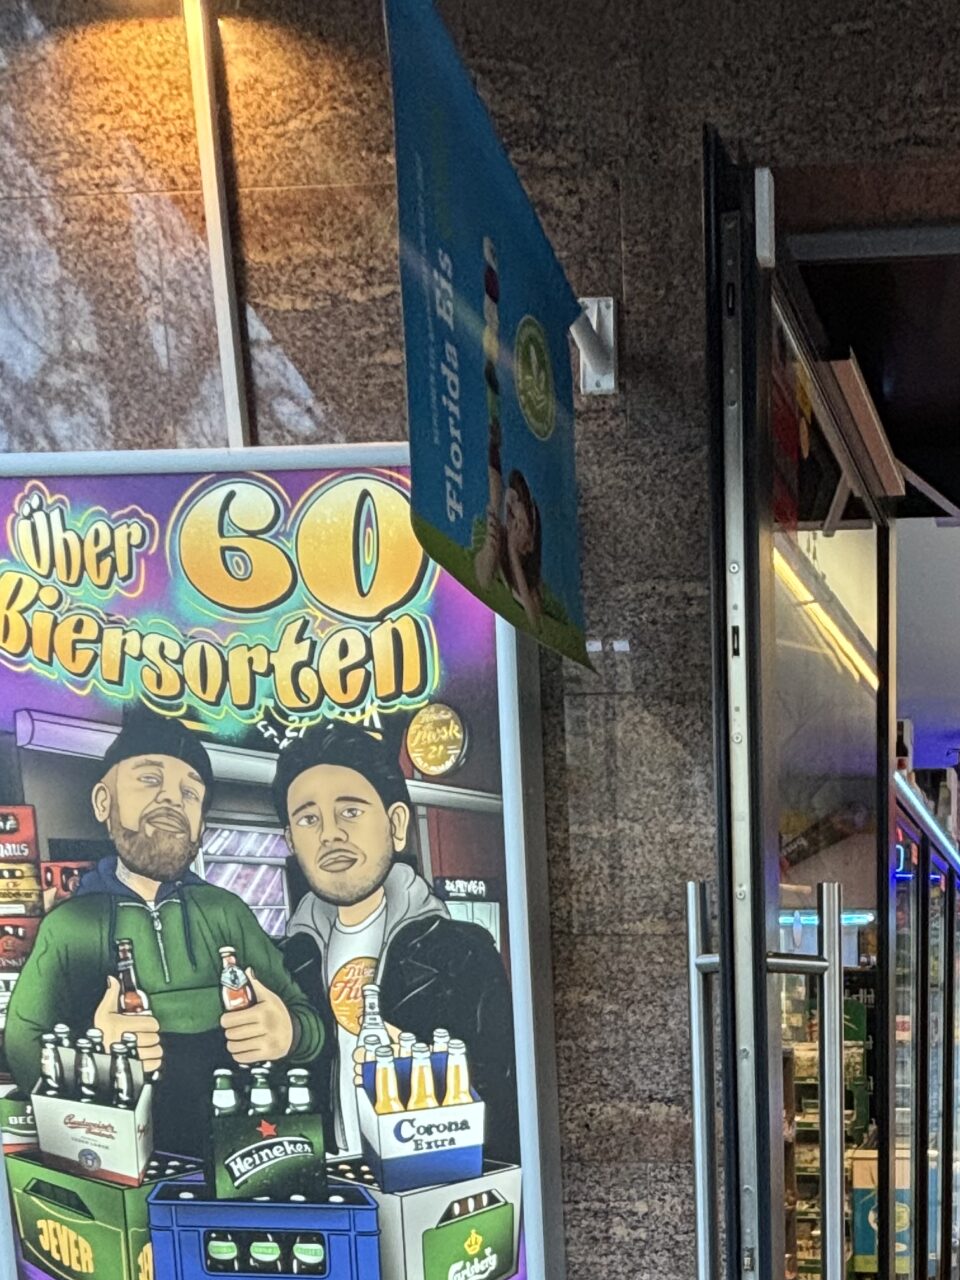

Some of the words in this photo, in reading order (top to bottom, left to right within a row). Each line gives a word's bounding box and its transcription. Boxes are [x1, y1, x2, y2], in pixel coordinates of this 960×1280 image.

[431, 246, 455, 335] Eis
[440, 341, 464, 524] Florida
[16, 493, 147, 588] Über
[178, 473, 429, 622] 60
[0, 569, 429, 711] Biersorten
[229, 1138, 313, 1179] Heineken
[393, 1117, 471, 1144] Corona
[412, 1135, 457, 1152] Extra
[36, 1218, 95, 1275] JEVER
